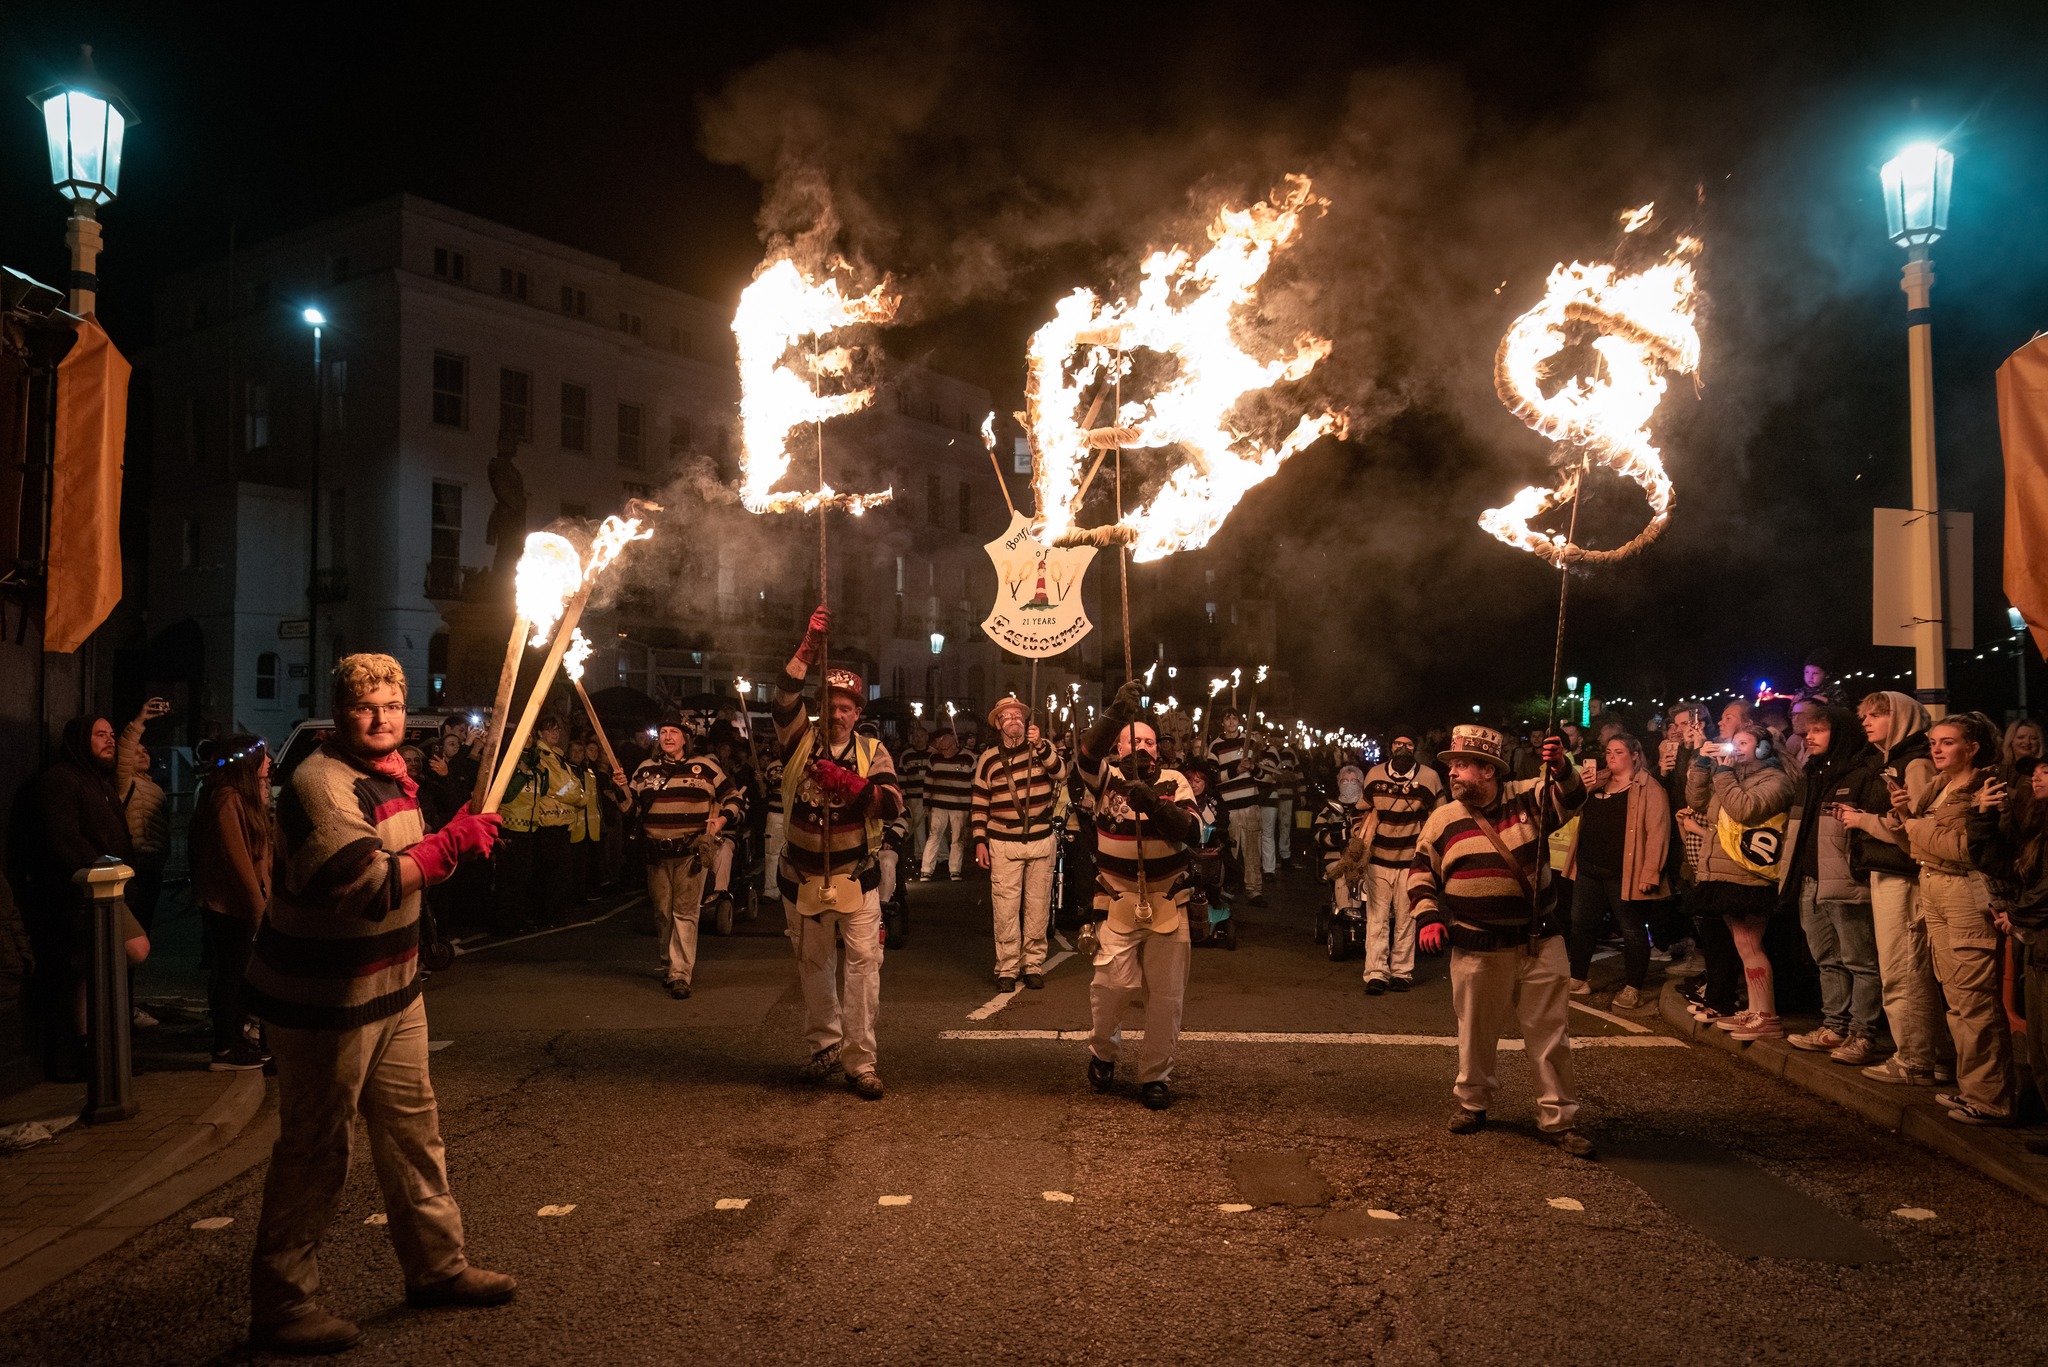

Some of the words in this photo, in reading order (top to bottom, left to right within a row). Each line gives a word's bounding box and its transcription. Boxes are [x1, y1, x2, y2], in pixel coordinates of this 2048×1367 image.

[732, 258, 897, 515] E
[1479, 255, 1702, 564] S
[1005, 526, 1032, 551] Bonfi
[1035, 548, 1050, 561] of
[990, 614, 1086, 651] Eastbourne
[1032, 617, 1057, 626] YEARS
[1749, 830, 1778, 864] JD
